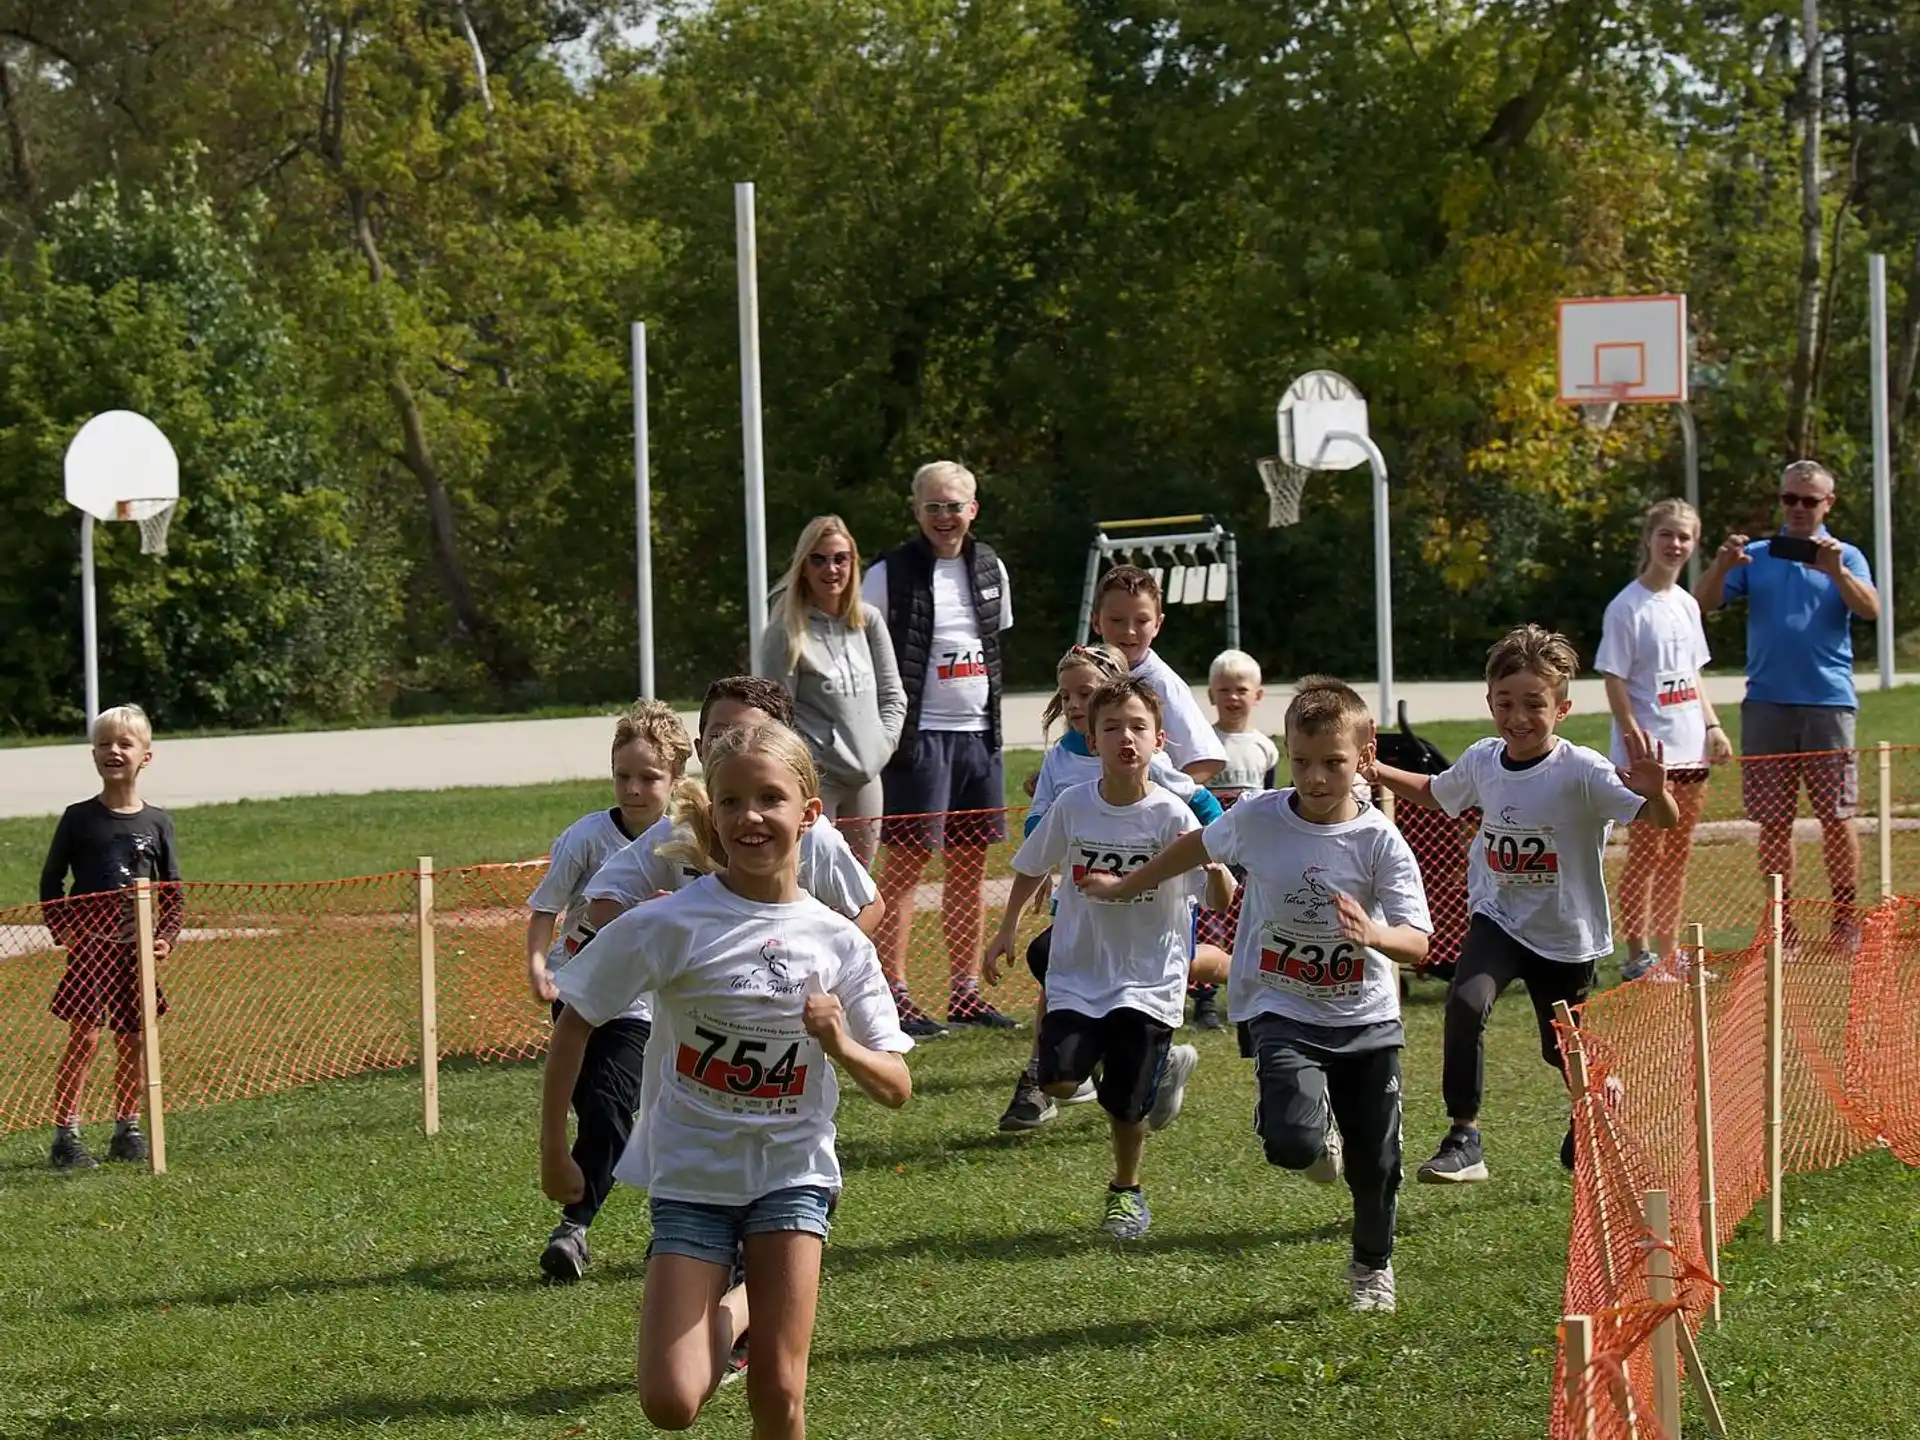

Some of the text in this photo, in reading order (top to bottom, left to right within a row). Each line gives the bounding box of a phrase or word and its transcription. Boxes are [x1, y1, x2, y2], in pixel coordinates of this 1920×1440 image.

[1483, 831, 1548, 873] 702
[1273, 935, 1355, 984] 736
[692, 1025, 800, 1095] 754
